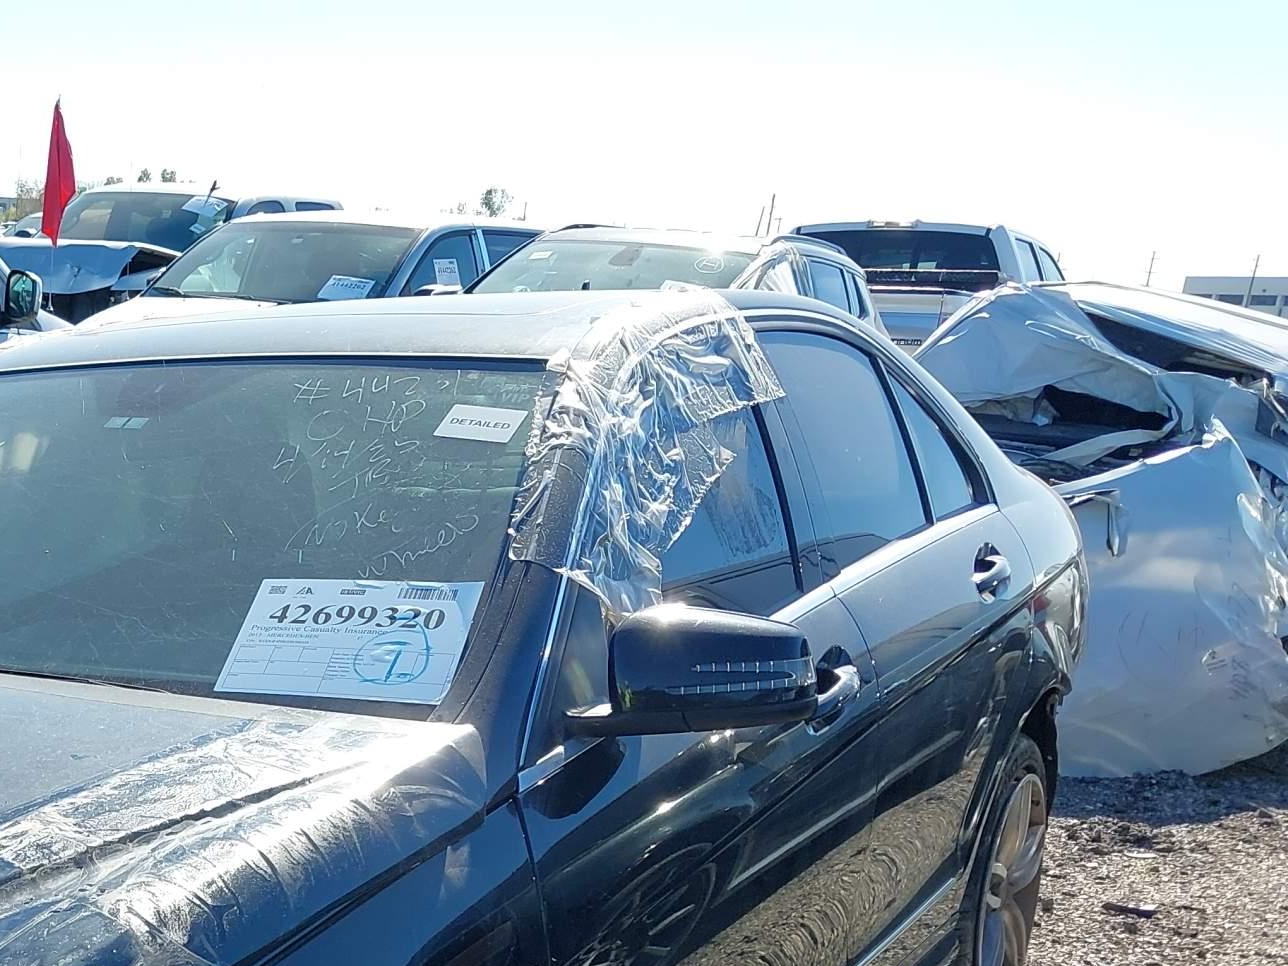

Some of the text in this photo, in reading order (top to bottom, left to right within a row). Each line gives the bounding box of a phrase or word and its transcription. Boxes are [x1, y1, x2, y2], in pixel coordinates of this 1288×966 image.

[450, 417, 511, 430] DETAILED
[269, 604, 446, 631] 42699320
[250, 624, 388, 635] Progressive Casualty Insurance
